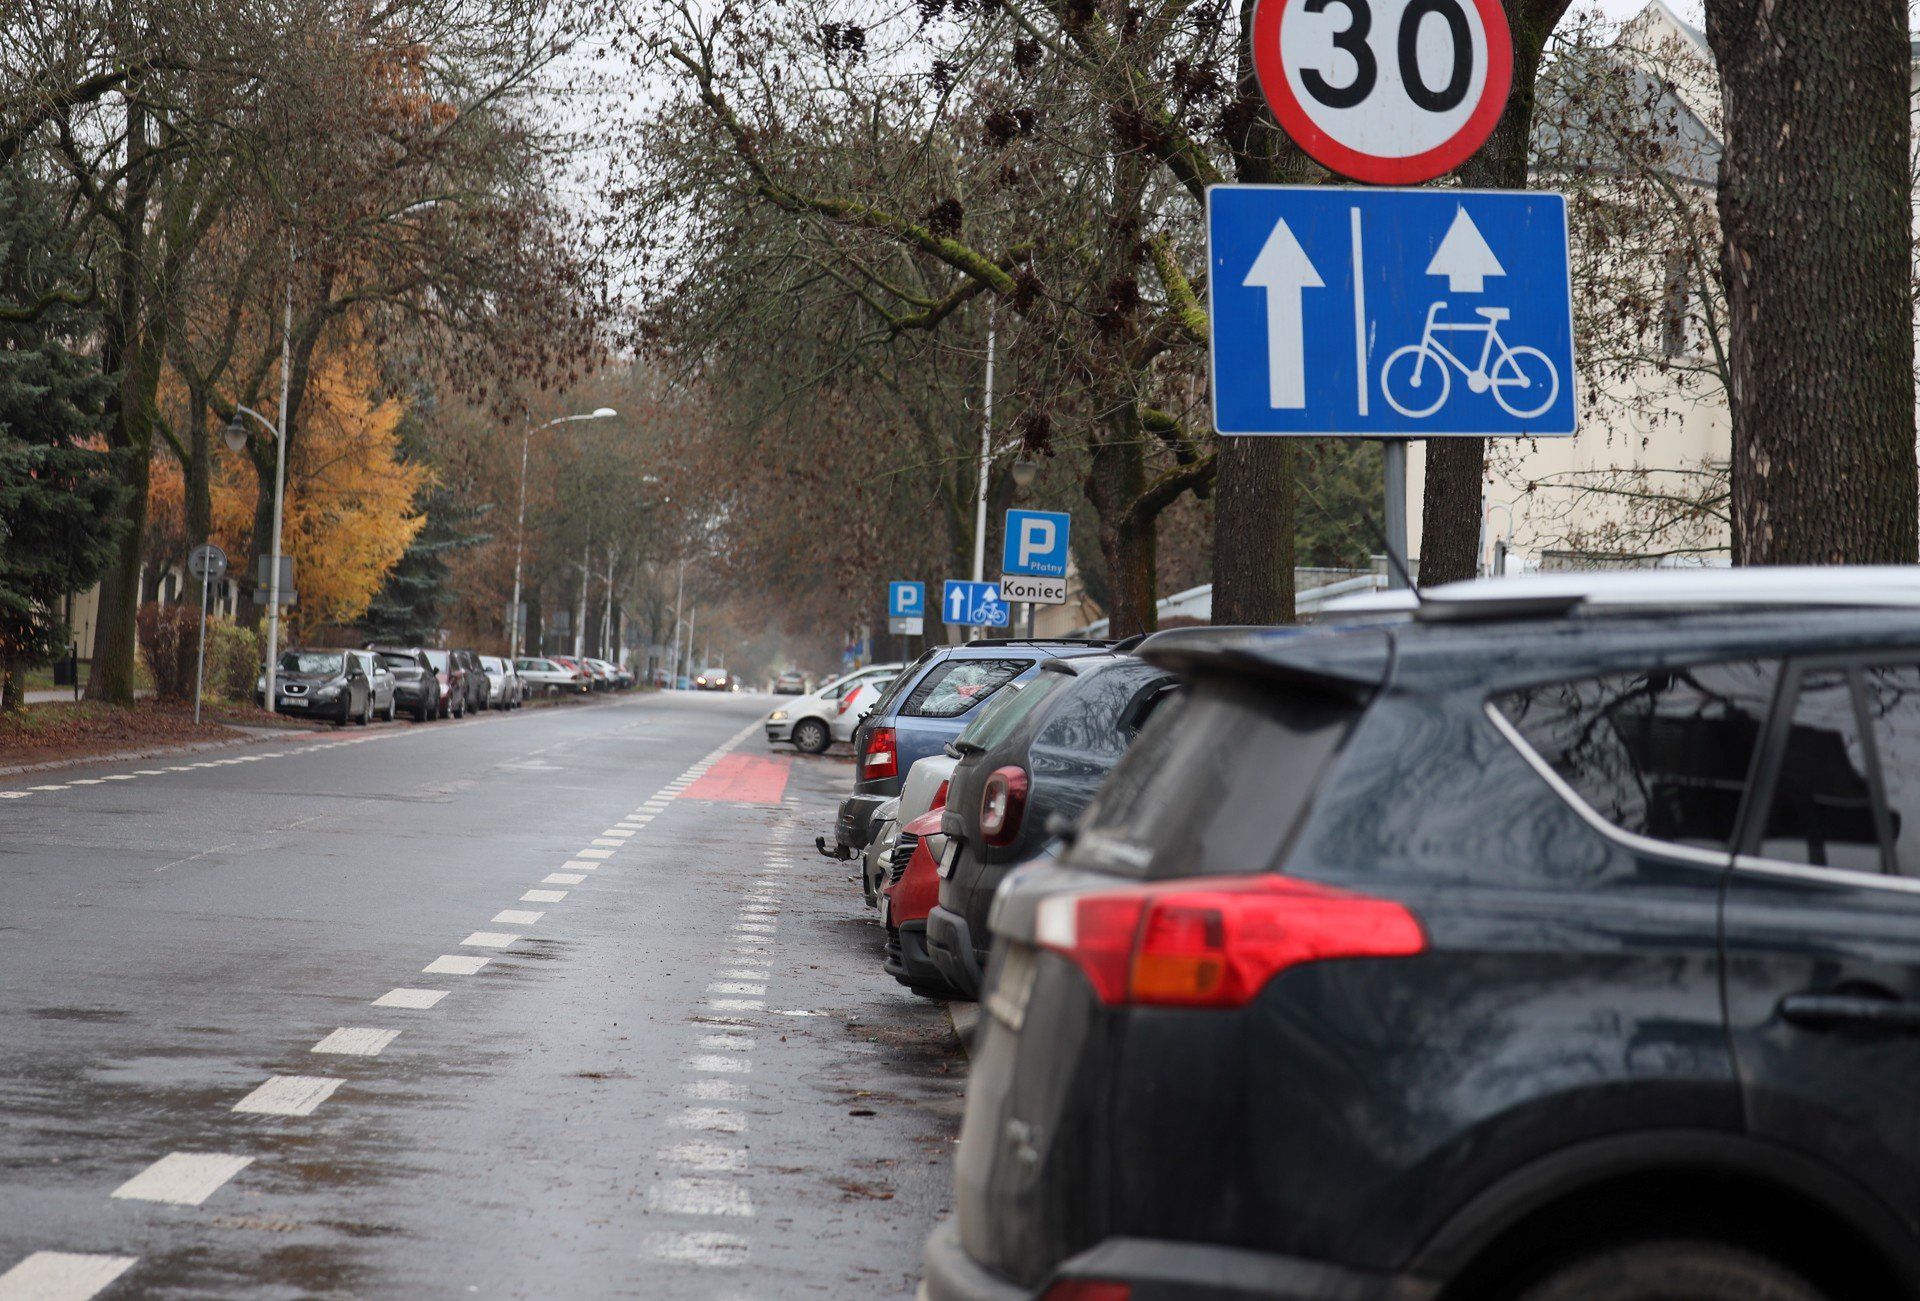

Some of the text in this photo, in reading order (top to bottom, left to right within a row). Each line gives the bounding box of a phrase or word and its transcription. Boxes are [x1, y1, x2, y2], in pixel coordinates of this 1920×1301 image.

[1299, 0, 1473, 112] 30
[1018, 517, 1056, 567] P
[1030, 561, 1063, 574] Płatny
[897, 585, 918, 613] P
[1003, 581, 1064, 599] Koniec
